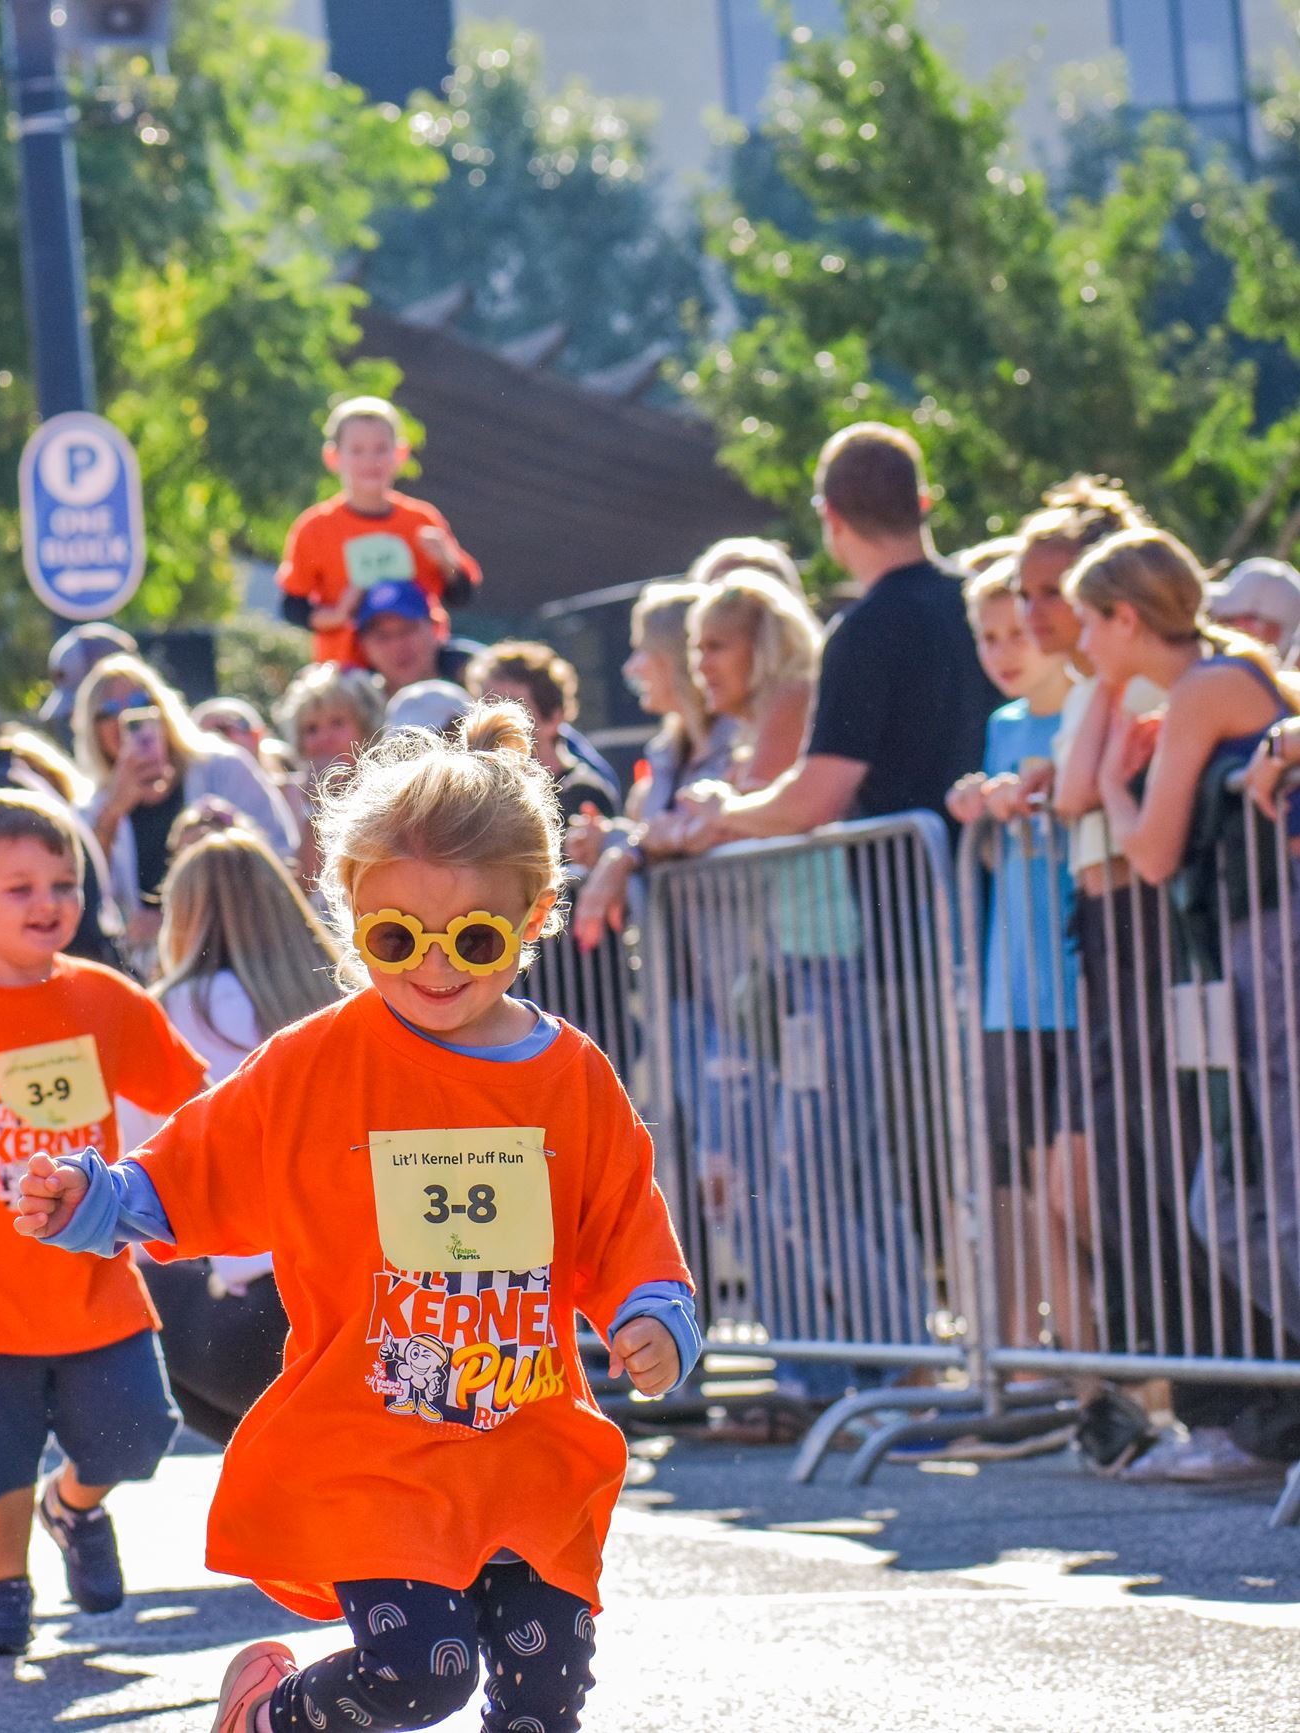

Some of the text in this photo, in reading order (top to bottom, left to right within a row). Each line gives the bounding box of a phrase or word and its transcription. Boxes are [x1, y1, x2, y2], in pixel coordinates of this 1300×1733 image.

[67, 444, 98, 487] P
[27, 1076, 71, 1107] 3-9
[421, 1152, 463, 1165] Kernel
[467, 1151, 496, 1164] Puff
[498, 1151, 524, 1164] Run
[422, 1183, 498, 1224] 3-8
[366, 1272, 557, 1347] KERNE
[473, 1405, 515, 1430] RU
